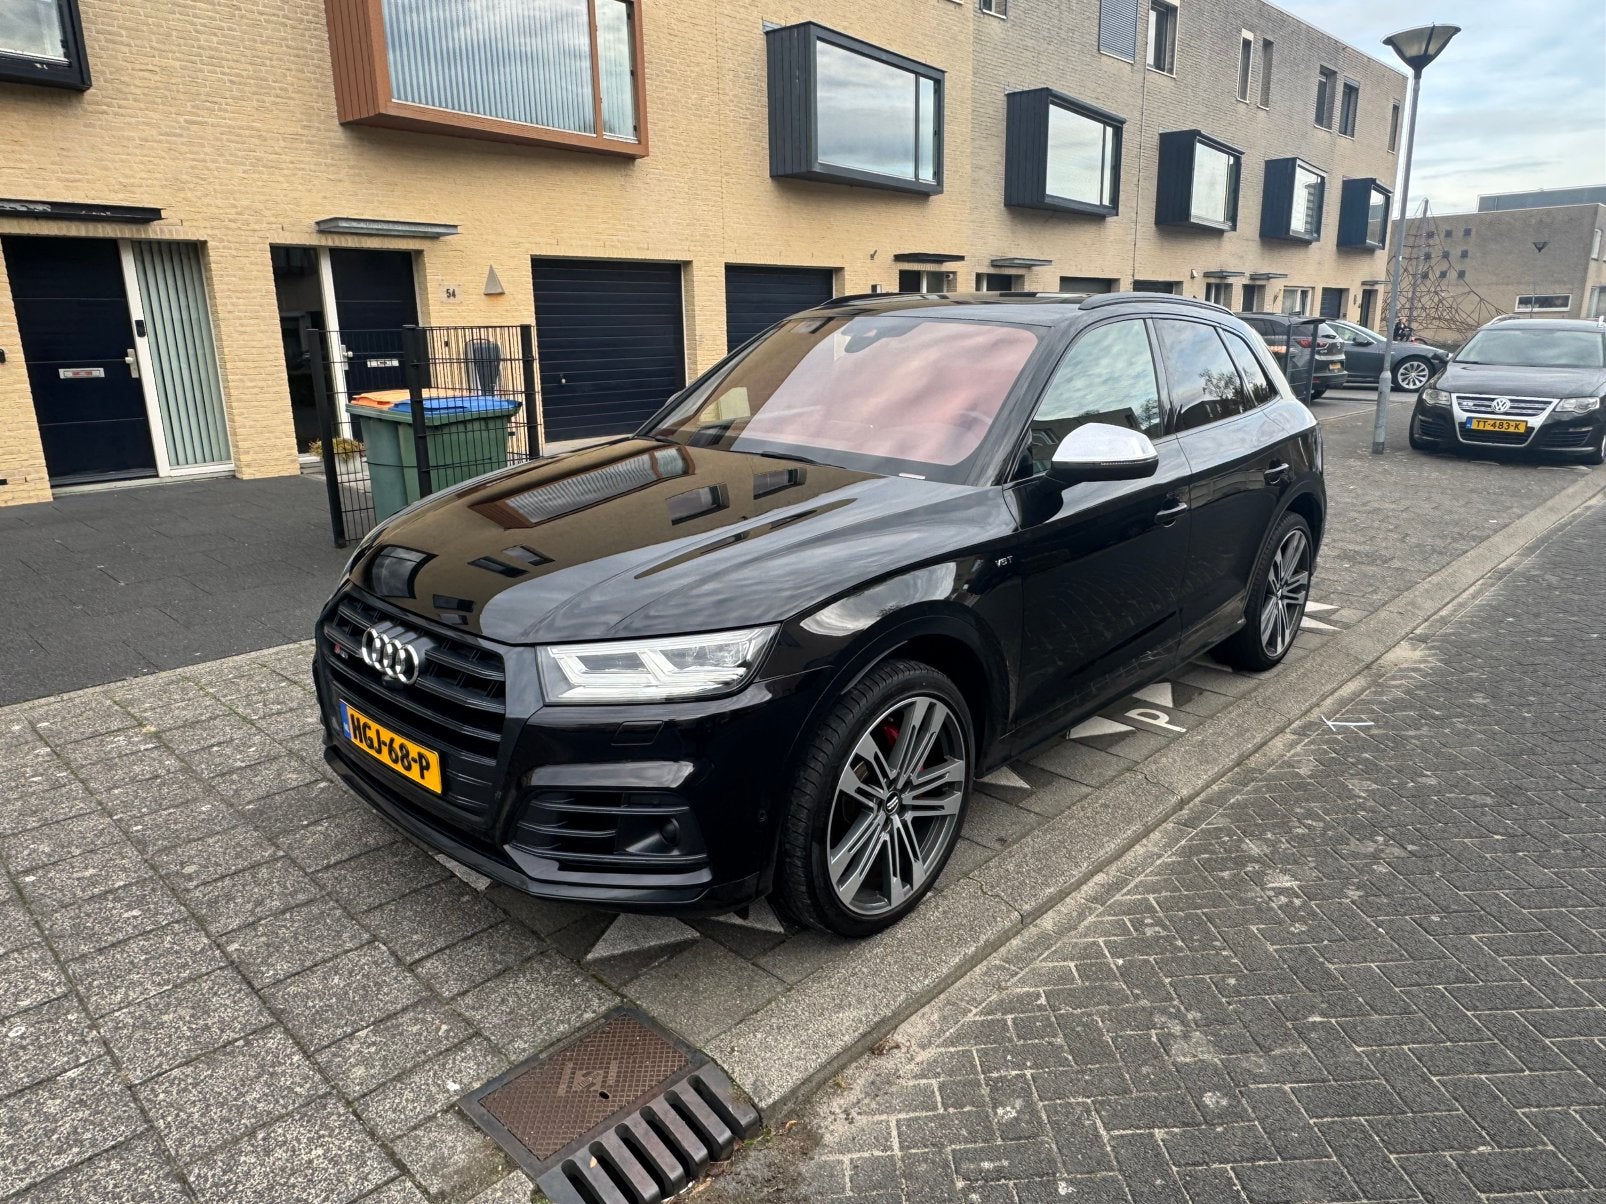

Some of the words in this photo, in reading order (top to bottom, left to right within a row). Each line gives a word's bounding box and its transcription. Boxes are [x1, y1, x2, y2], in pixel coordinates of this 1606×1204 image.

[446, 288, 457, 299] 54
[1476, 419, 1521, 431] TT-483-K
[1123, 708, 1187, 733] P
[350, 713, 431, 780] HGJ-68-P
